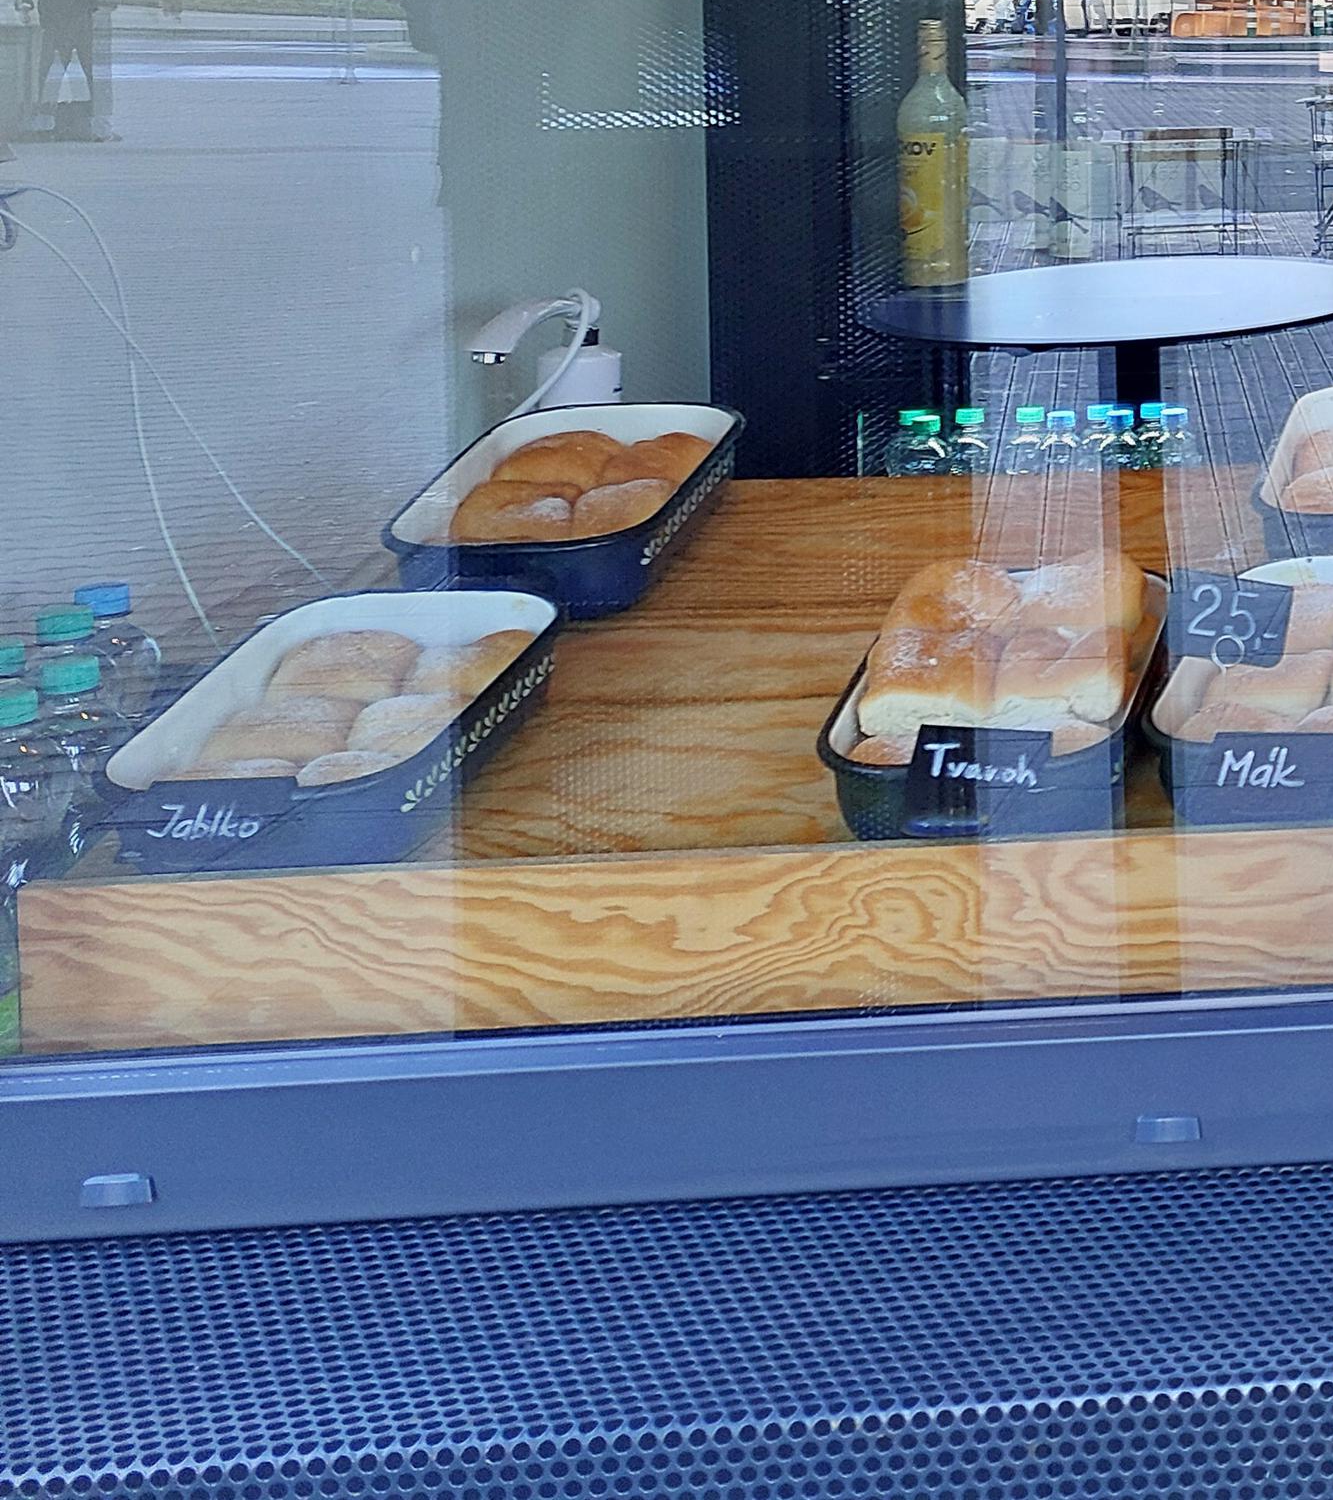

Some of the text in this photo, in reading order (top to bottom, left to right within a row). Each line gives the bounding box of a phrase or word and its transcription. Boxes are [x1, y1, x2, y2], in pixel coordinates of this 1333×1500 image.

[923, 742, 1038, 788] Tvaroh
[1216, 746, 1305, 789] Mák
[146, 801, 260, 840] Jablko
